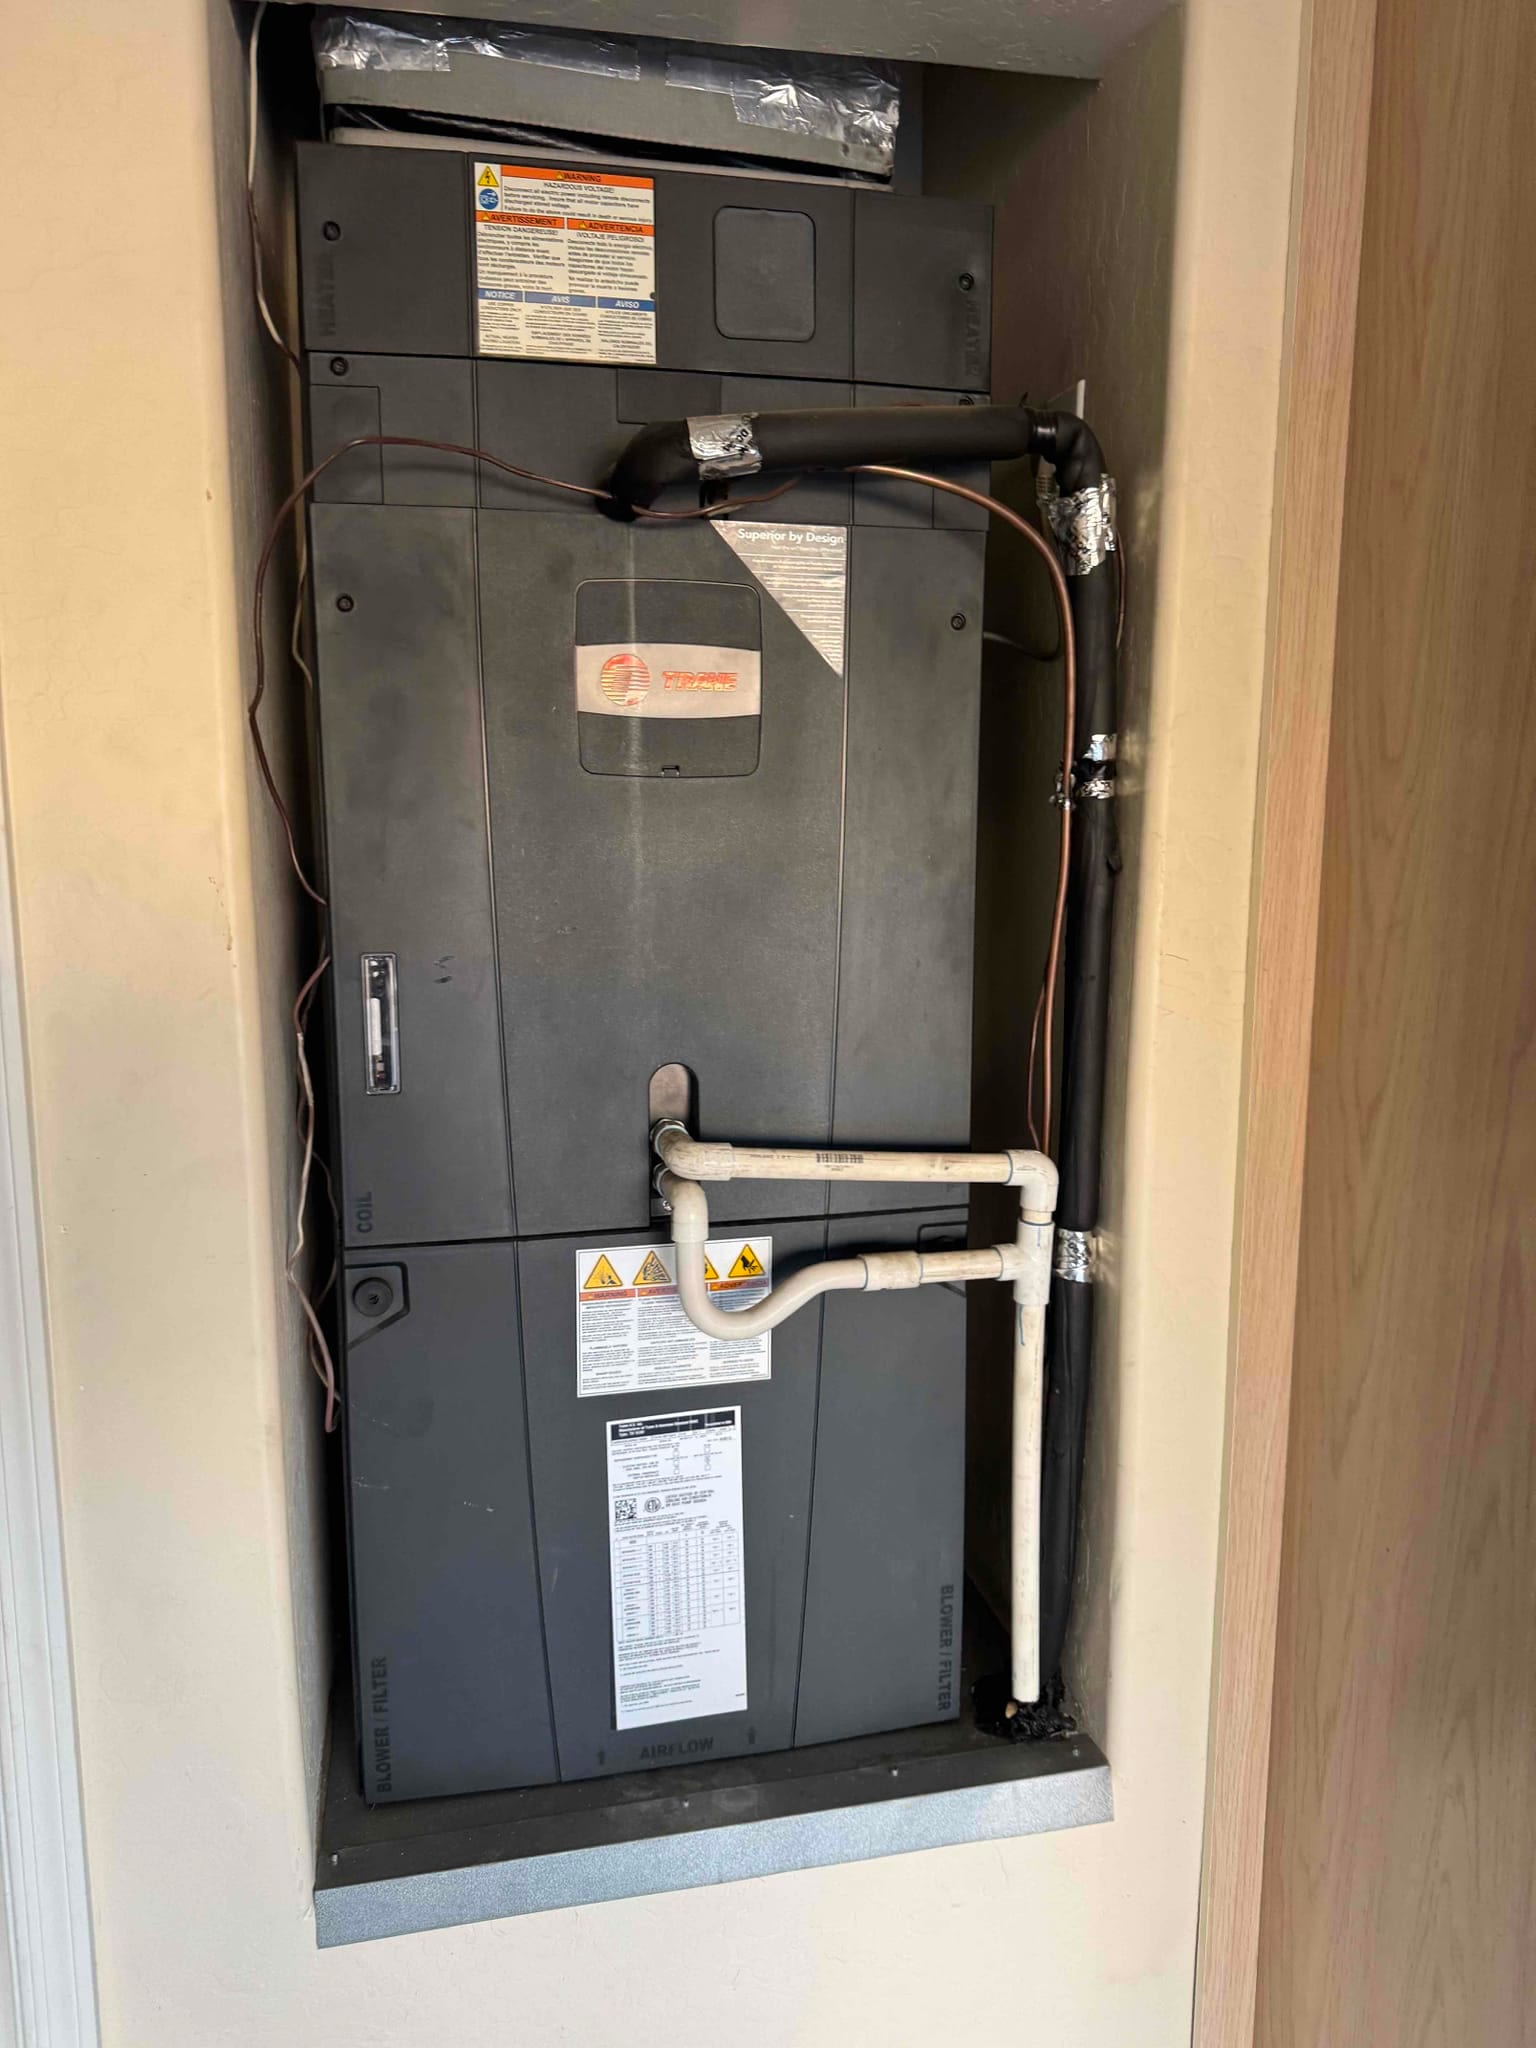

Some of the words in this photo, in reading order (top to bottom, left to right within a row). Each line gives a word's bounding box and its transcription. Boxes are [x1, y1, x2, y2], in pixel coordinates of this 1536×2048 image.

[564, 172, 601, 182] WARNING
[491, 214, 557, 226] AVERTISSEMENT
[588, 222, 644, 233] ADVERTENCIA
[485, 290, 516, 300] NOTICE
[552, 296, 570, 304] AVIS
[615, 300, 640, 309] AVISO
[737, 528, 786, 542] Superior
[788, 530, 803, 544] by
[806, 532, 844, 546] Design
[662, 671, 738, 692] TRANE
[356, 1191, 373, 1234] COIL
[939, 1584, 954, 1649] BLOWER
[371, 1656, 389, 1713] FILTER
[937, 1659, 952, 1712] FILTER
[640, 1736, 714, 1759] AIRFLOW
[374, 1726, 392, 1793] BLOWER
